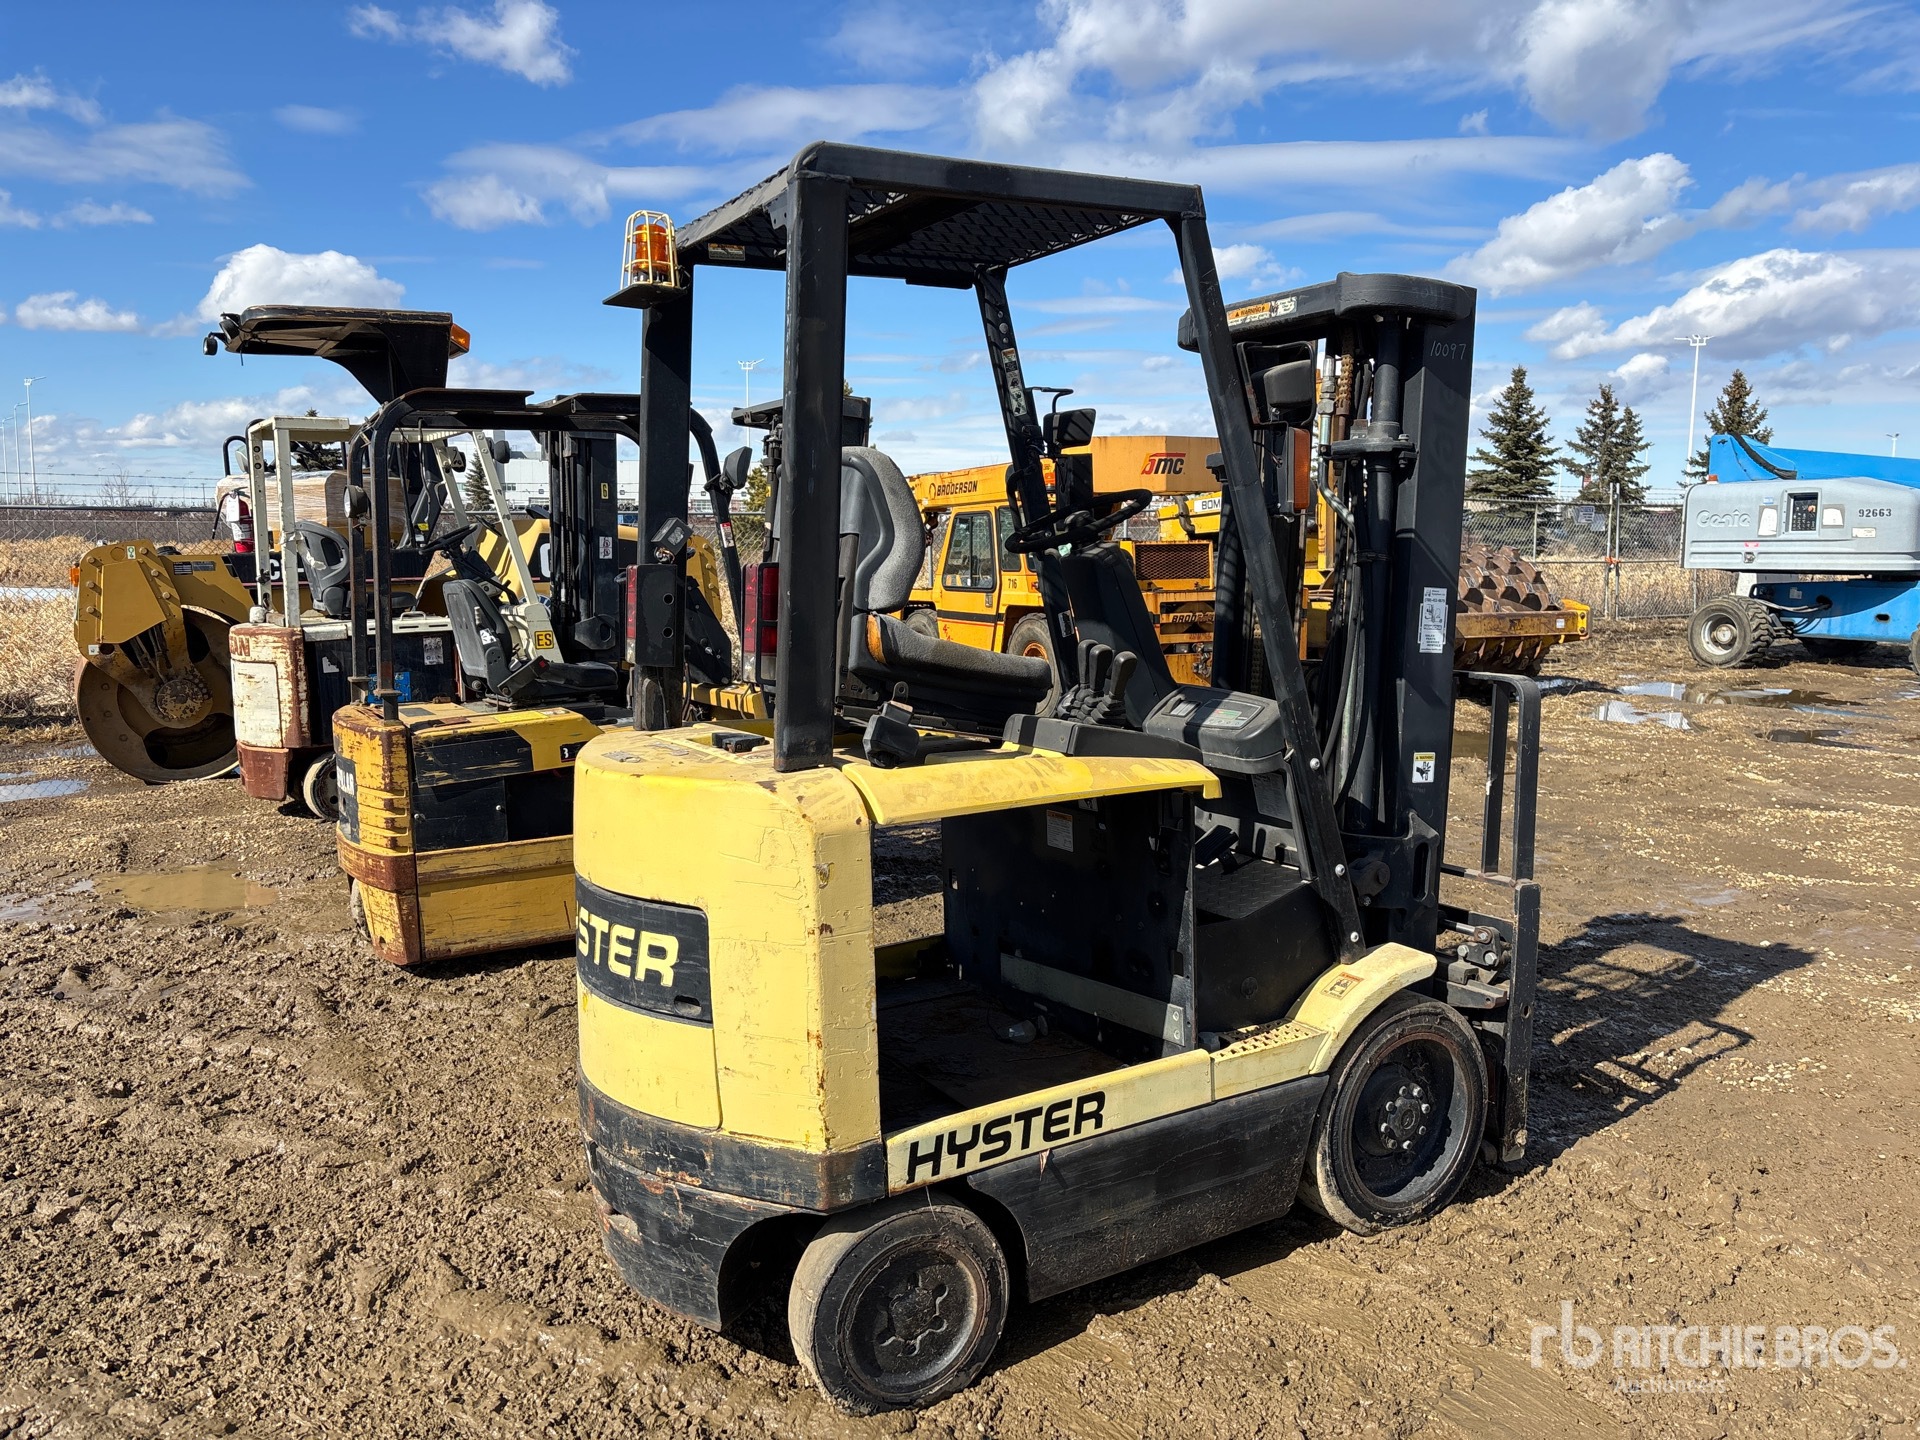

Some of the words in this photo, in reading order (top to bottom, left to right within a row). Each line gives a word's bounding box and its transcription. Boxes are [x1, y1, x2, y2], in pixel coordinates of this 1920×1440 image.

[1430, 340, 1467, 360] 10097
[936, 480, 979, 497] BRODERSON
[1696, 509, 1751, 528] Genie
[1858, 508, 1892, 518] 92663
[1007, 578, 1018, 589] 716
[537, 632, 552, 646] ES
[577, 905, 680, 989] STER
[905, 1090, 1107, 1185] HYSTER
